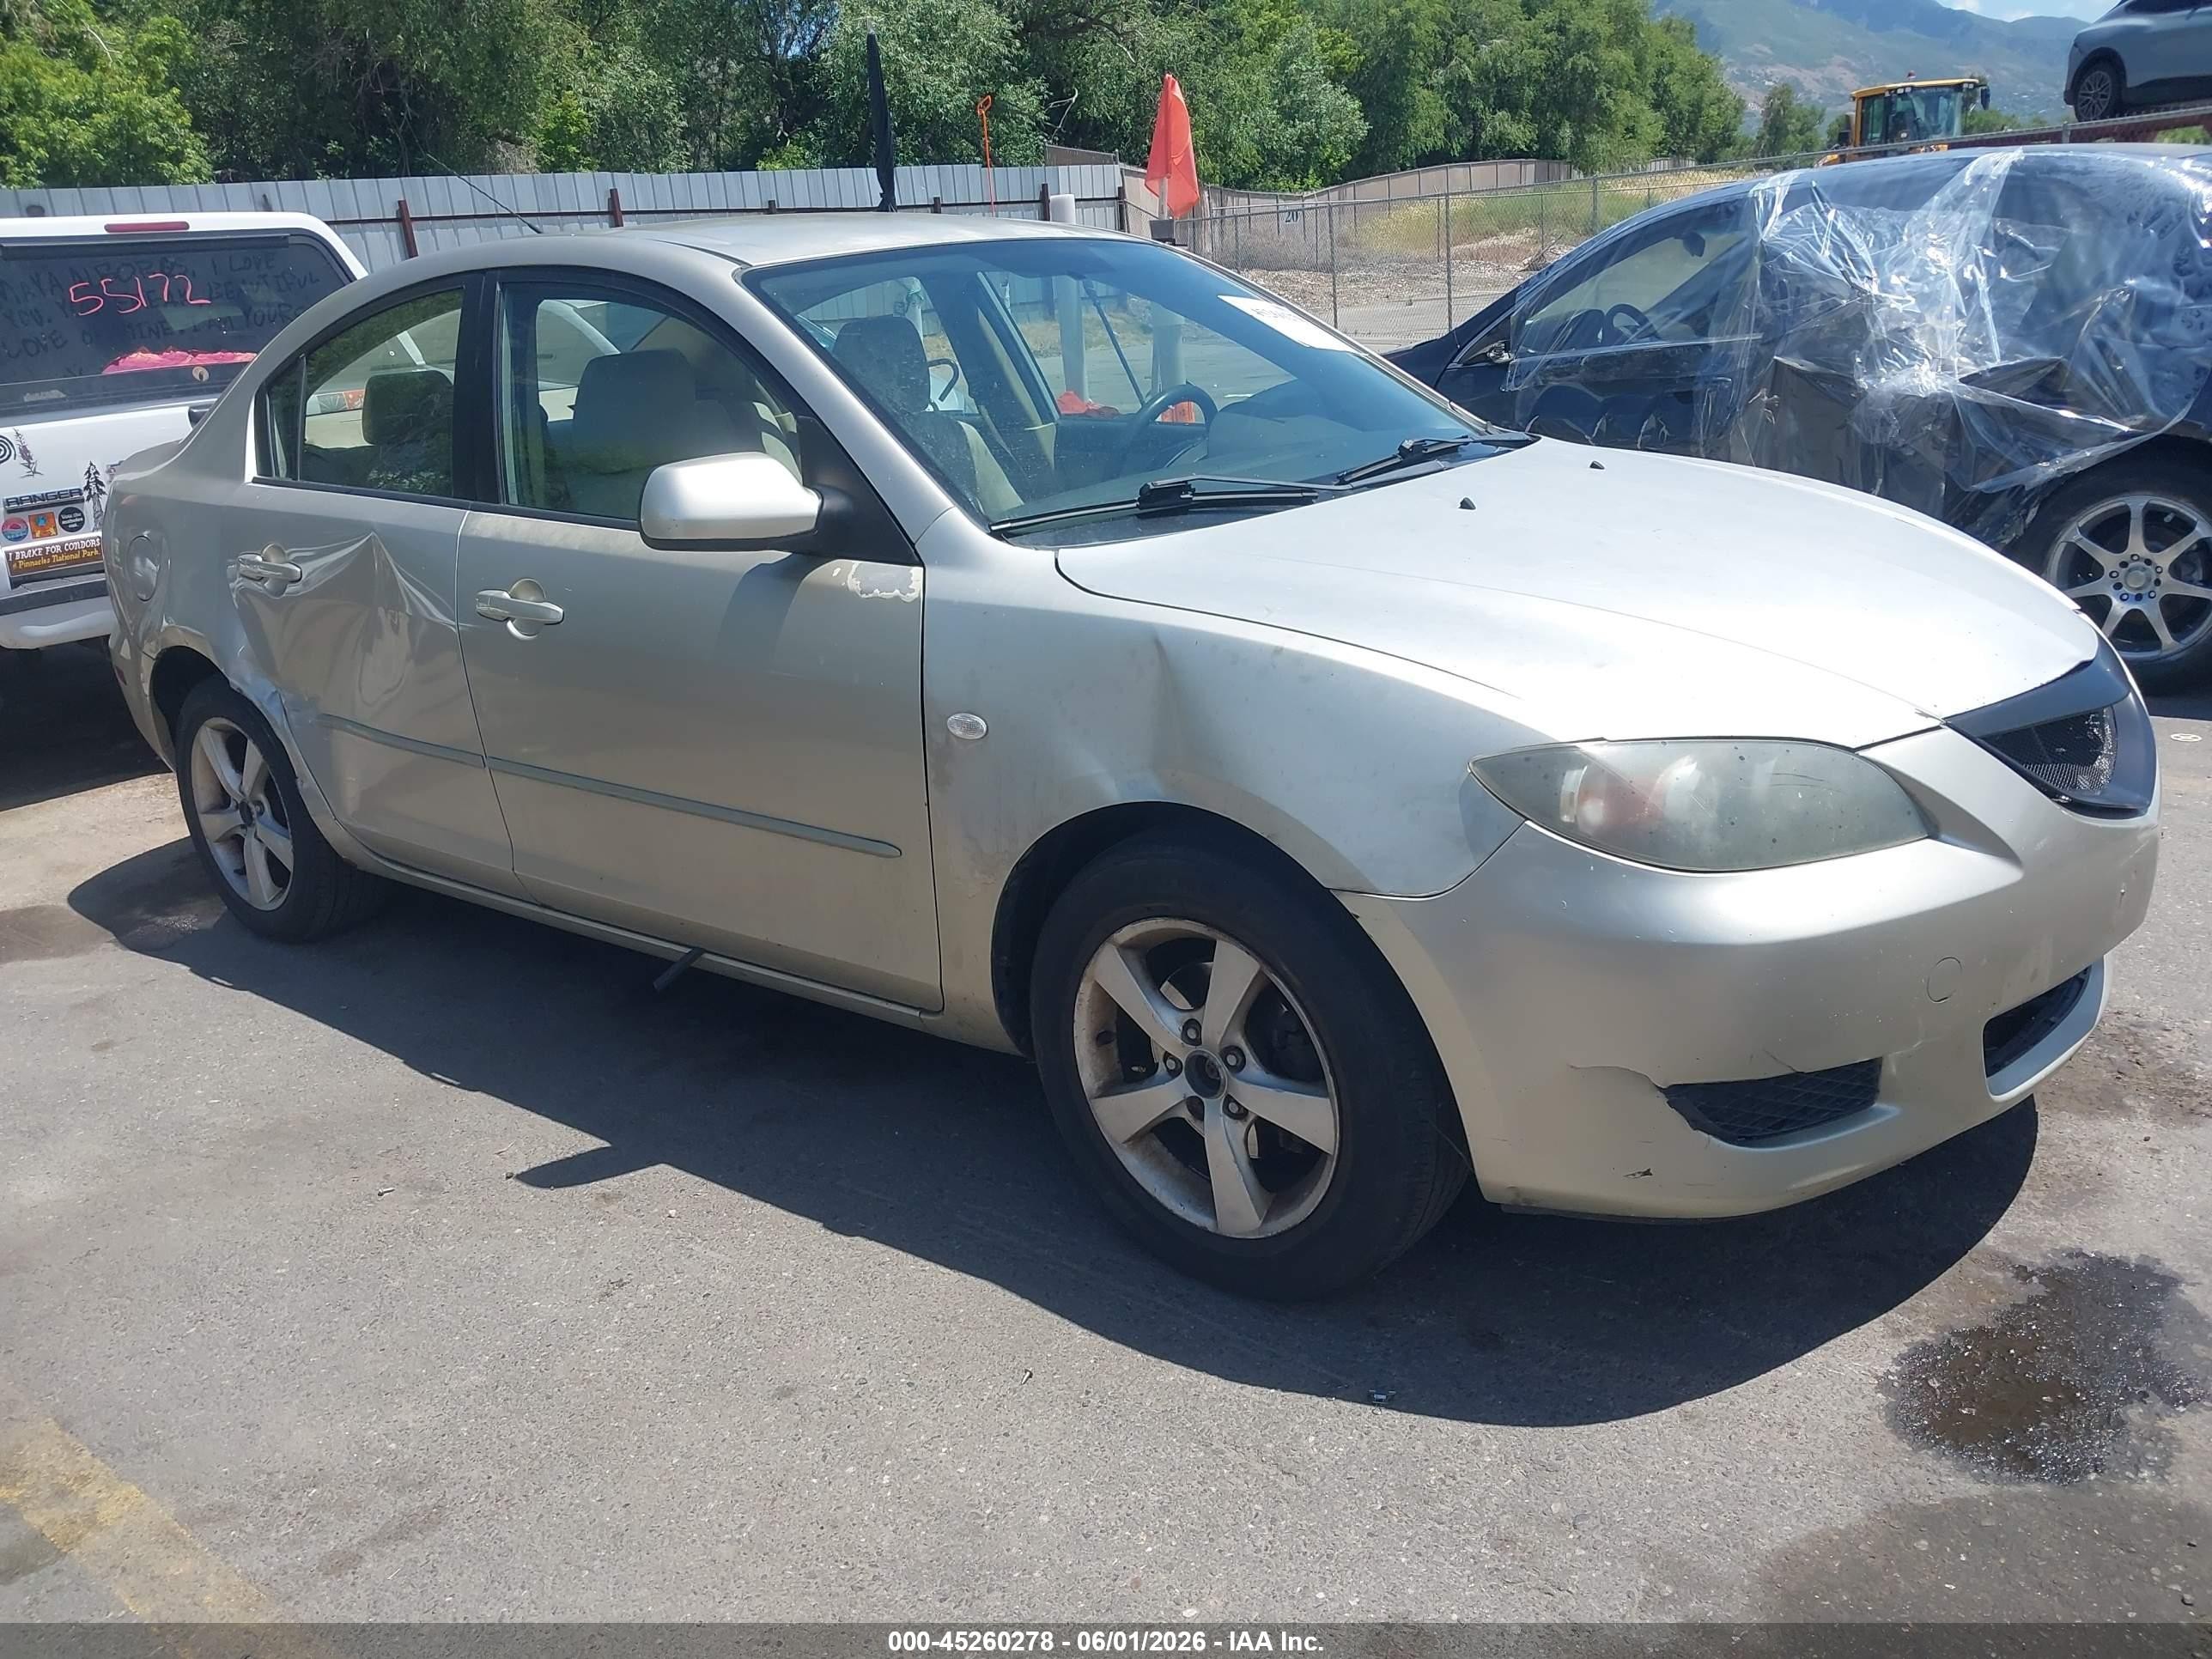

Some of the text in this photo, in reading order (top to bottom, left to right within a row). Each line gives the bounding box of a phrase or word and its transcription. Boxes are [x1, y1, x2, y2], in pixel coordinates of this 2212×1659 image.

[229, 252, 275, 273] LOVE
[69, 272, 211, 316] 55172
[6, 488, 84, 507] RANGER
[15, 547, 44, 560] BRAKE
[46, 544, 62, 555] FOR
[64, 538, 100, 551] CONDORS
[52, 551, 80, 563] National
